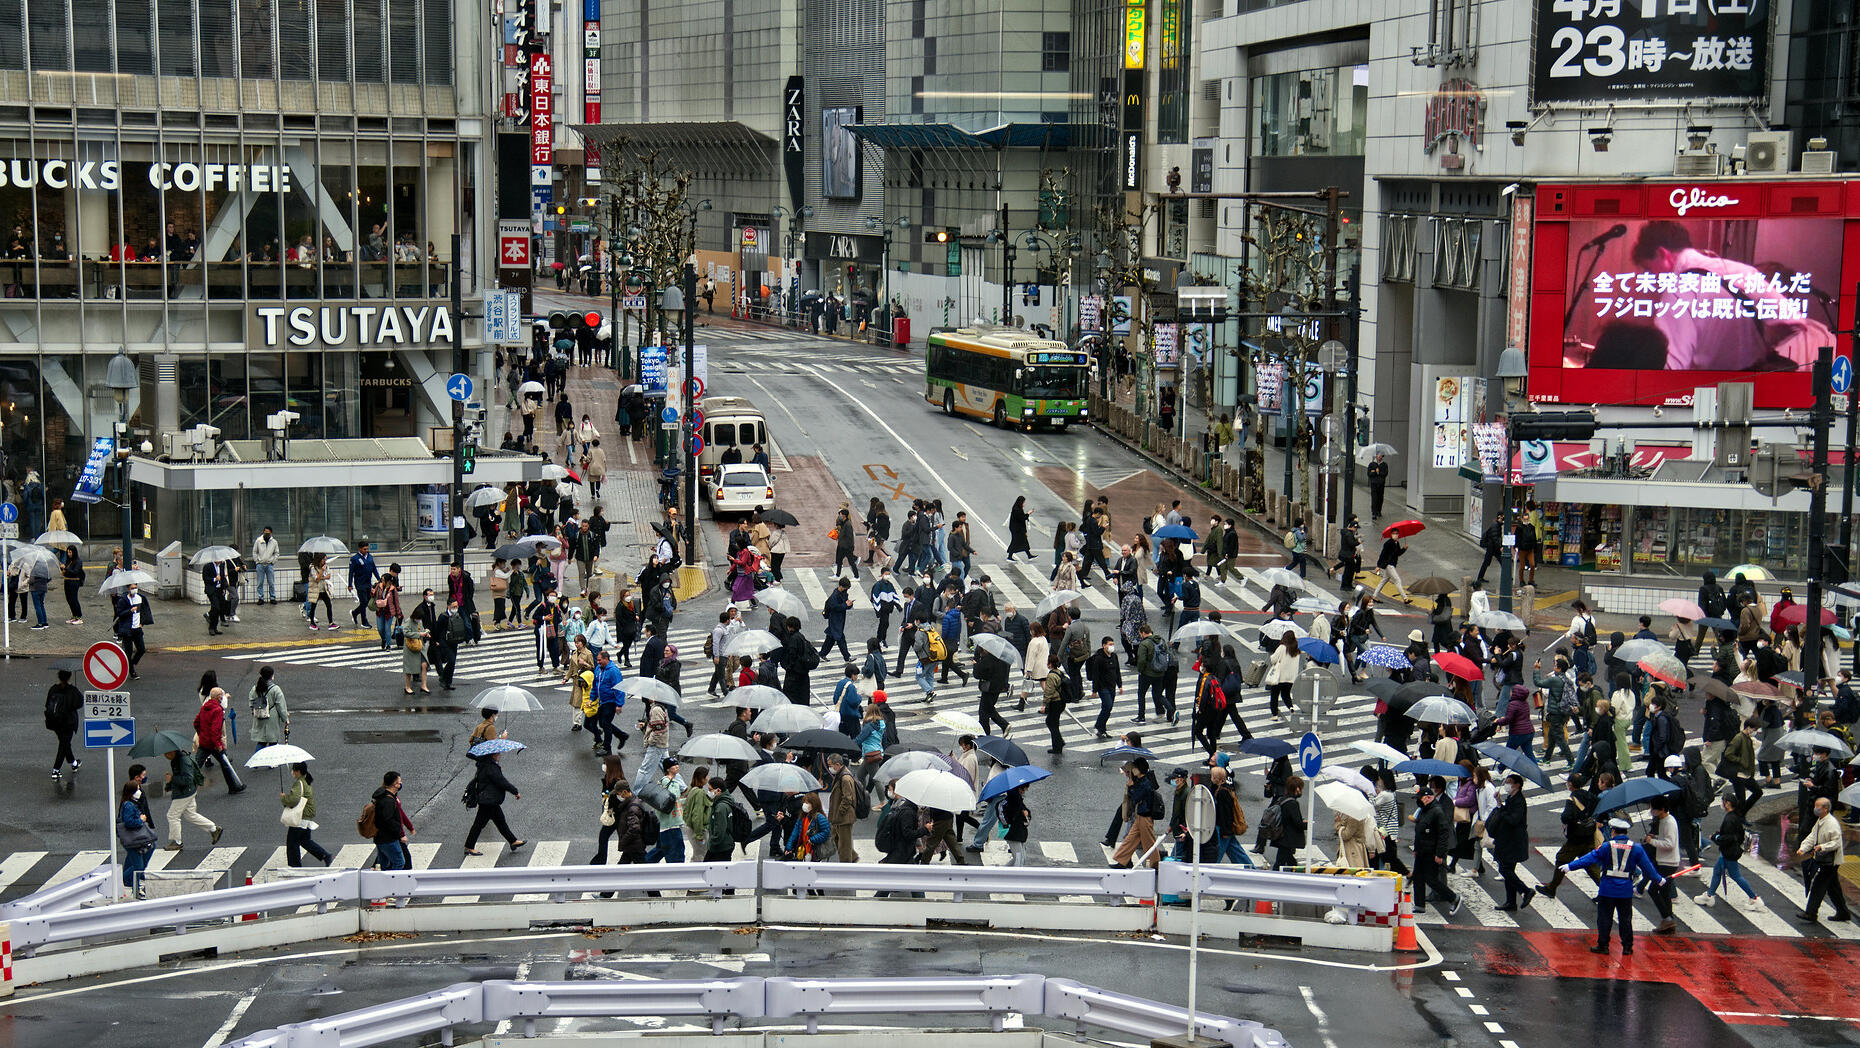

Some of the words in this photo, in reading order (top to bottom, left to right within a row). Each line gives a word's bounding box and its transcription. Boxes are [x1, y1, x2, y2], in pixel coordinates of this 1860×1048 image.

[1128, 0, 1143, 41] タクト
[534, 78, 550, 162] 東日本銀行
[787, 89, 802, 152] ZARA
[148, 162, 291, 192] COFFEE
[1127, 135, 1136, 187] McDonald's
[1669, 187, 1739, 216] Glico
[504, 239, 526, 262] 本
[829, 235, 859, 258] ZARA
[1513, 227, 1527, 342] 天津甘
[1593, 271, 1812, 294] 全て未発表曲で挑んだ
[257, 306, 454, 346] TSUTAYA
[493, 294, 504, 340] 渋谷駅前
[358, 378, 412, 386] TARBUCKS
[1562, 450, 1663, 469] くり
